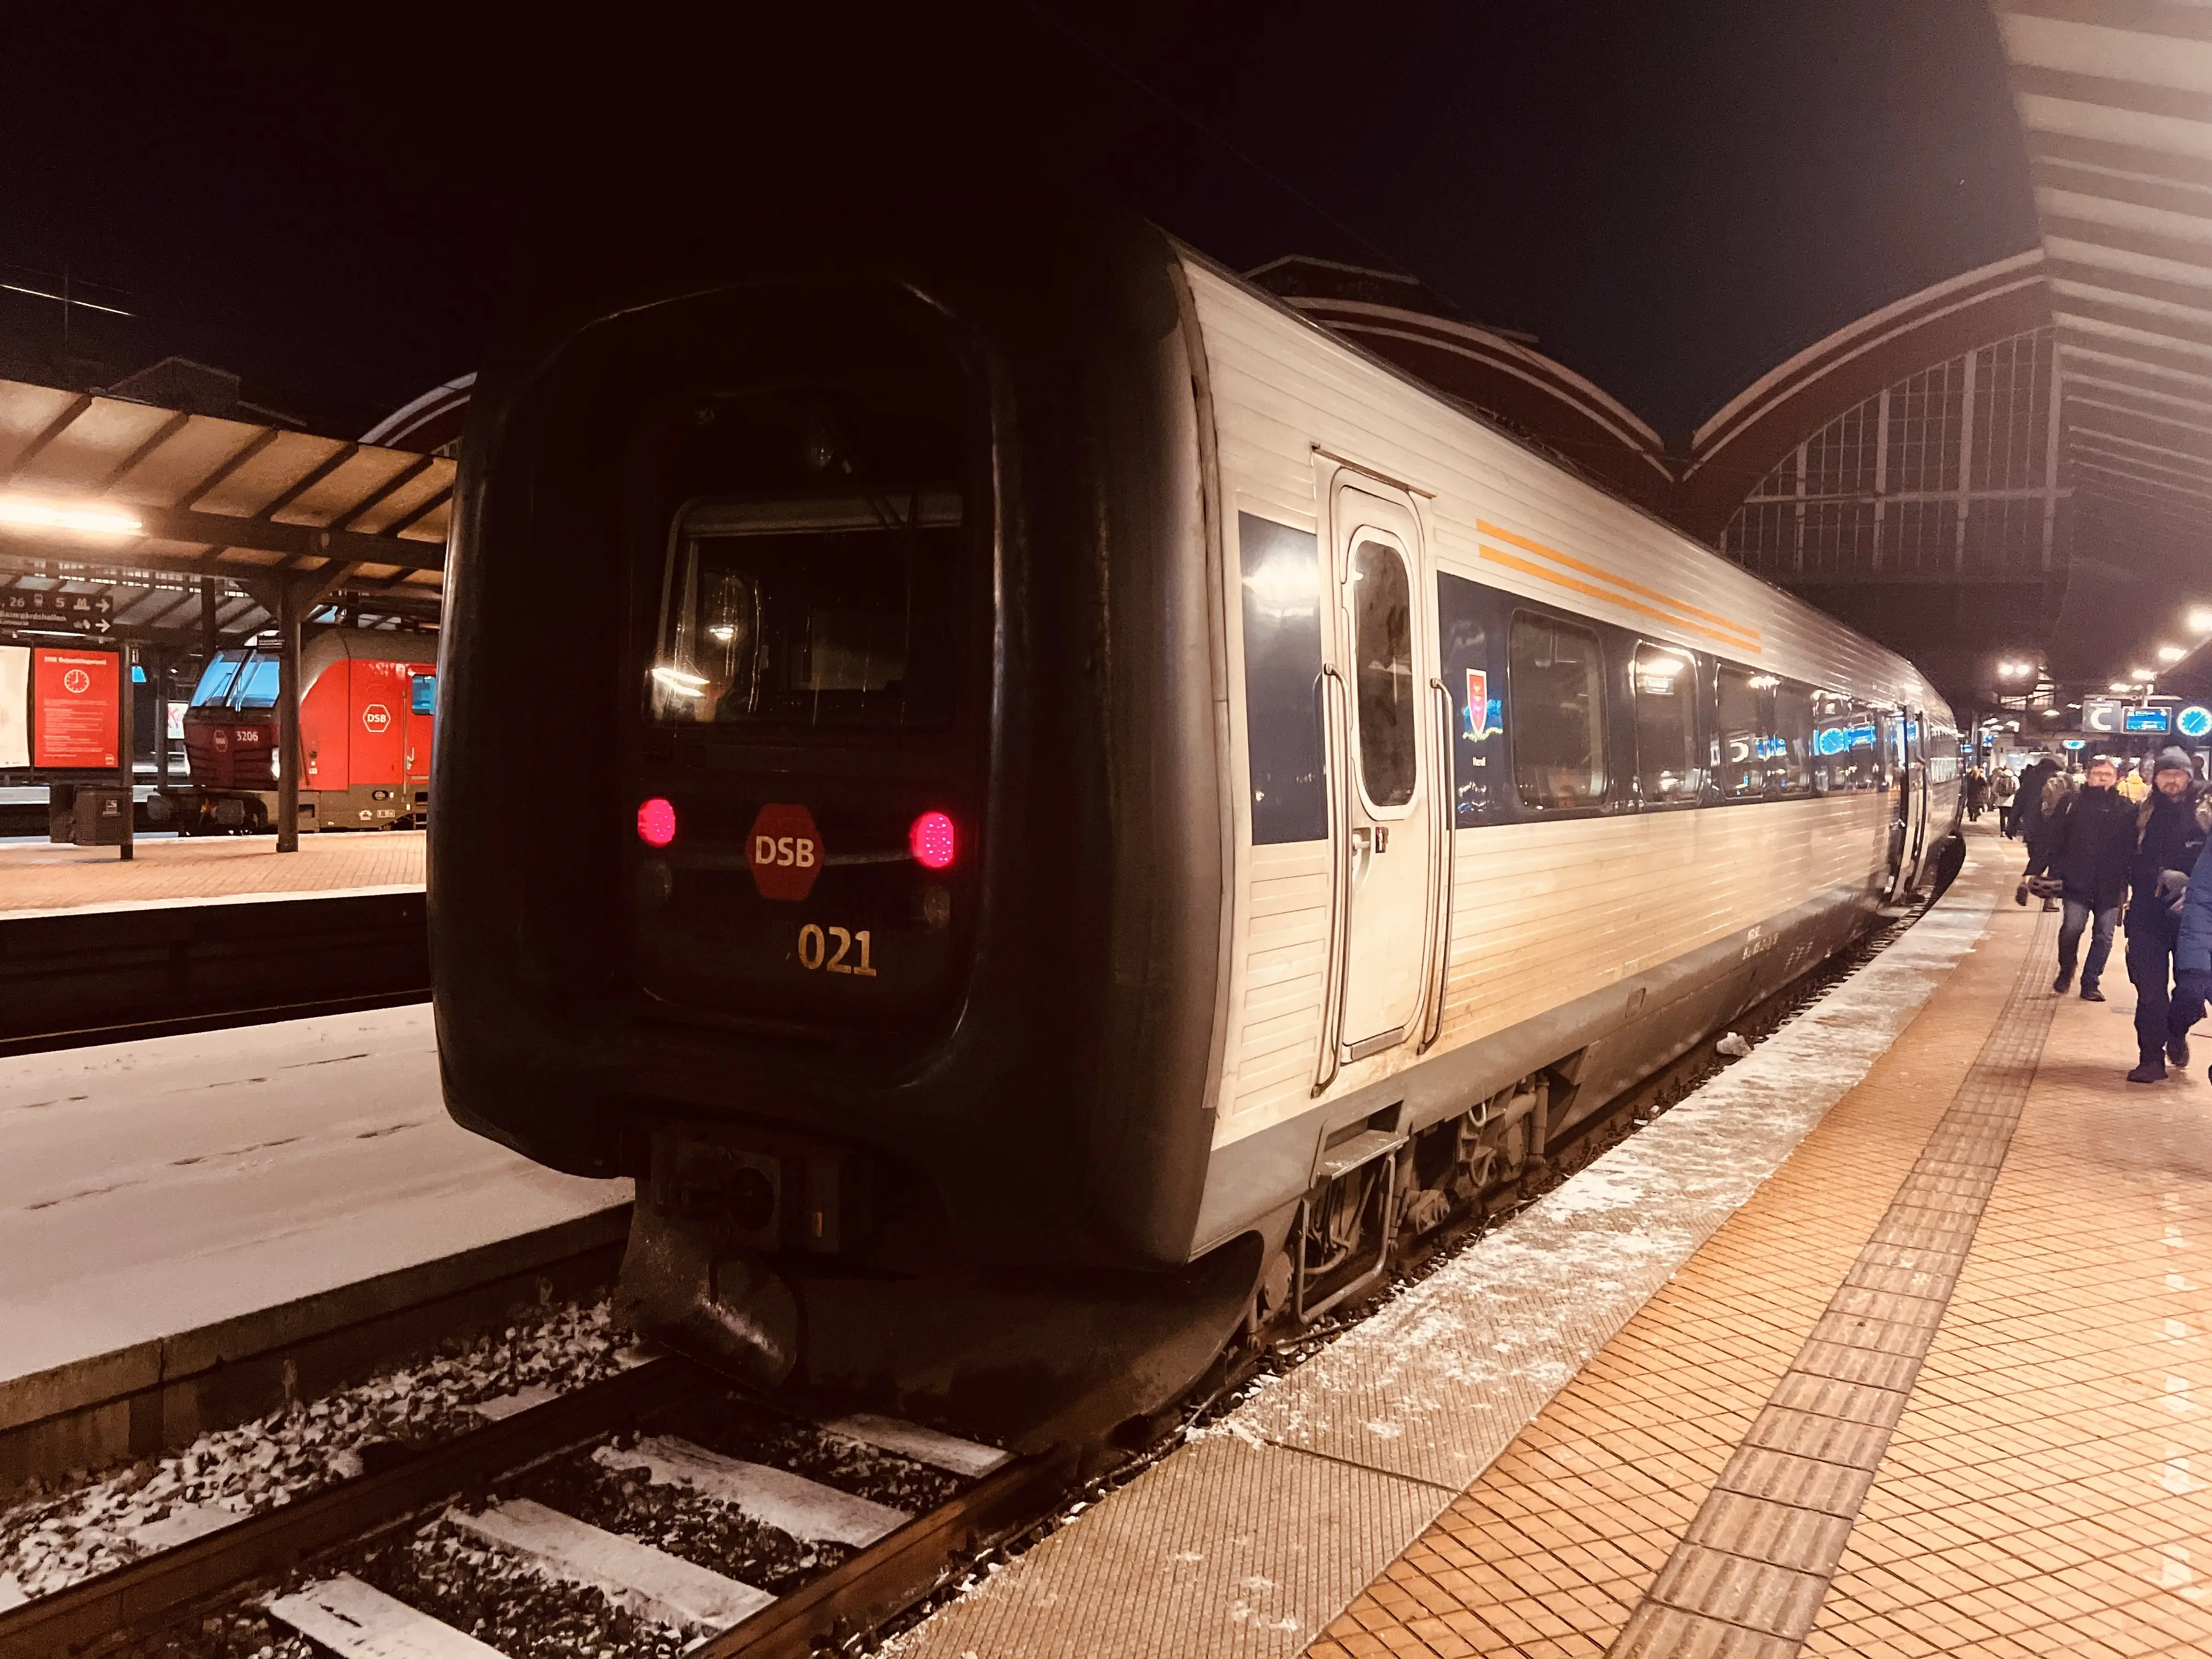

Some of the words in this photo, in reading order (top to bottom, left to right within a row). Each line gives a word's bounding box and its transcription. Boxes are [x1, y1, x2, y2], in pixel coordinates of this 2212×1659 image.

[9, 596, 25, 607] 26
[55, 597, 65, 607] 5
[366, 713, 386, 723] DSB
[2090, 707, 2112, 731] C
[236, 731, 258, 742] 3206
[755, 835, 815, 867] DSB
[798, 923, 877, 977] 021
